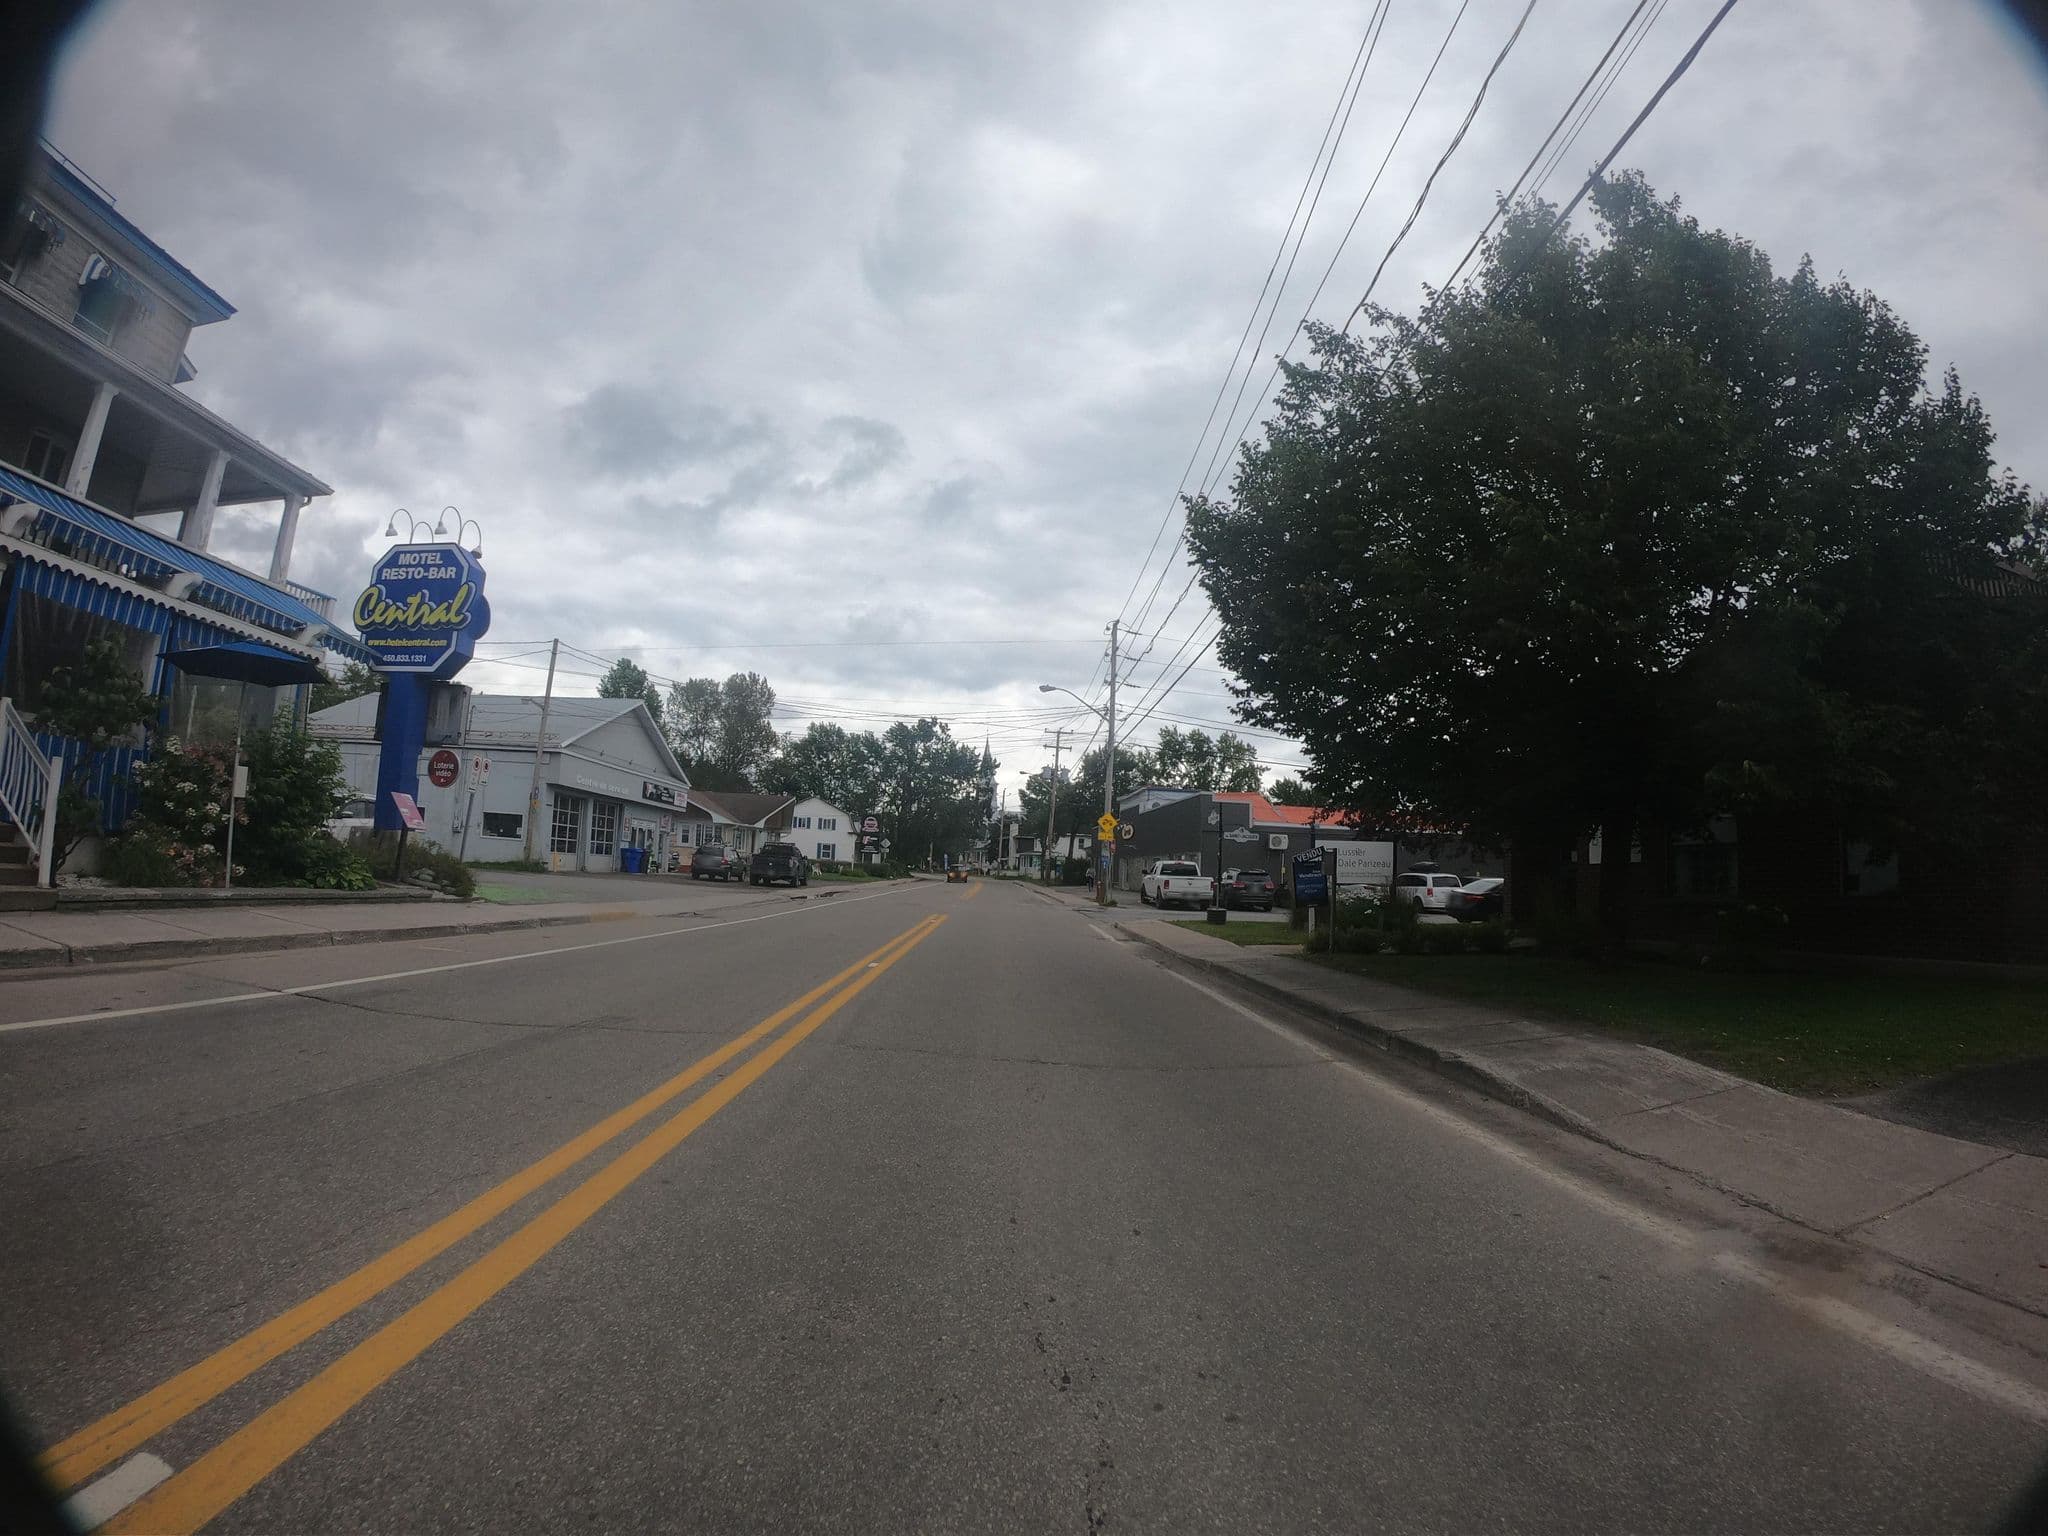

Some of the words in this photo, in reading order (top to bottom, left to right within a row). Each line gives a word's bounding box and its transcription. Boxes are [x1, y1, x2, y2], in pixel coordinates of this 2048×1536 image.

[398, 552, 443, 565] MOTEL
[381, 567, 456, 580] RESTO-BAR
[354, 584, 469, 626] Central
[433, 761, 455, 769] Loterie
[435, 769, 452, 777] vidéo
[1296, 847, 1323, 863] VENDU
[1338, 848, 1367, 857] Lussier
[1338, 858, 1356, 868] Dale
